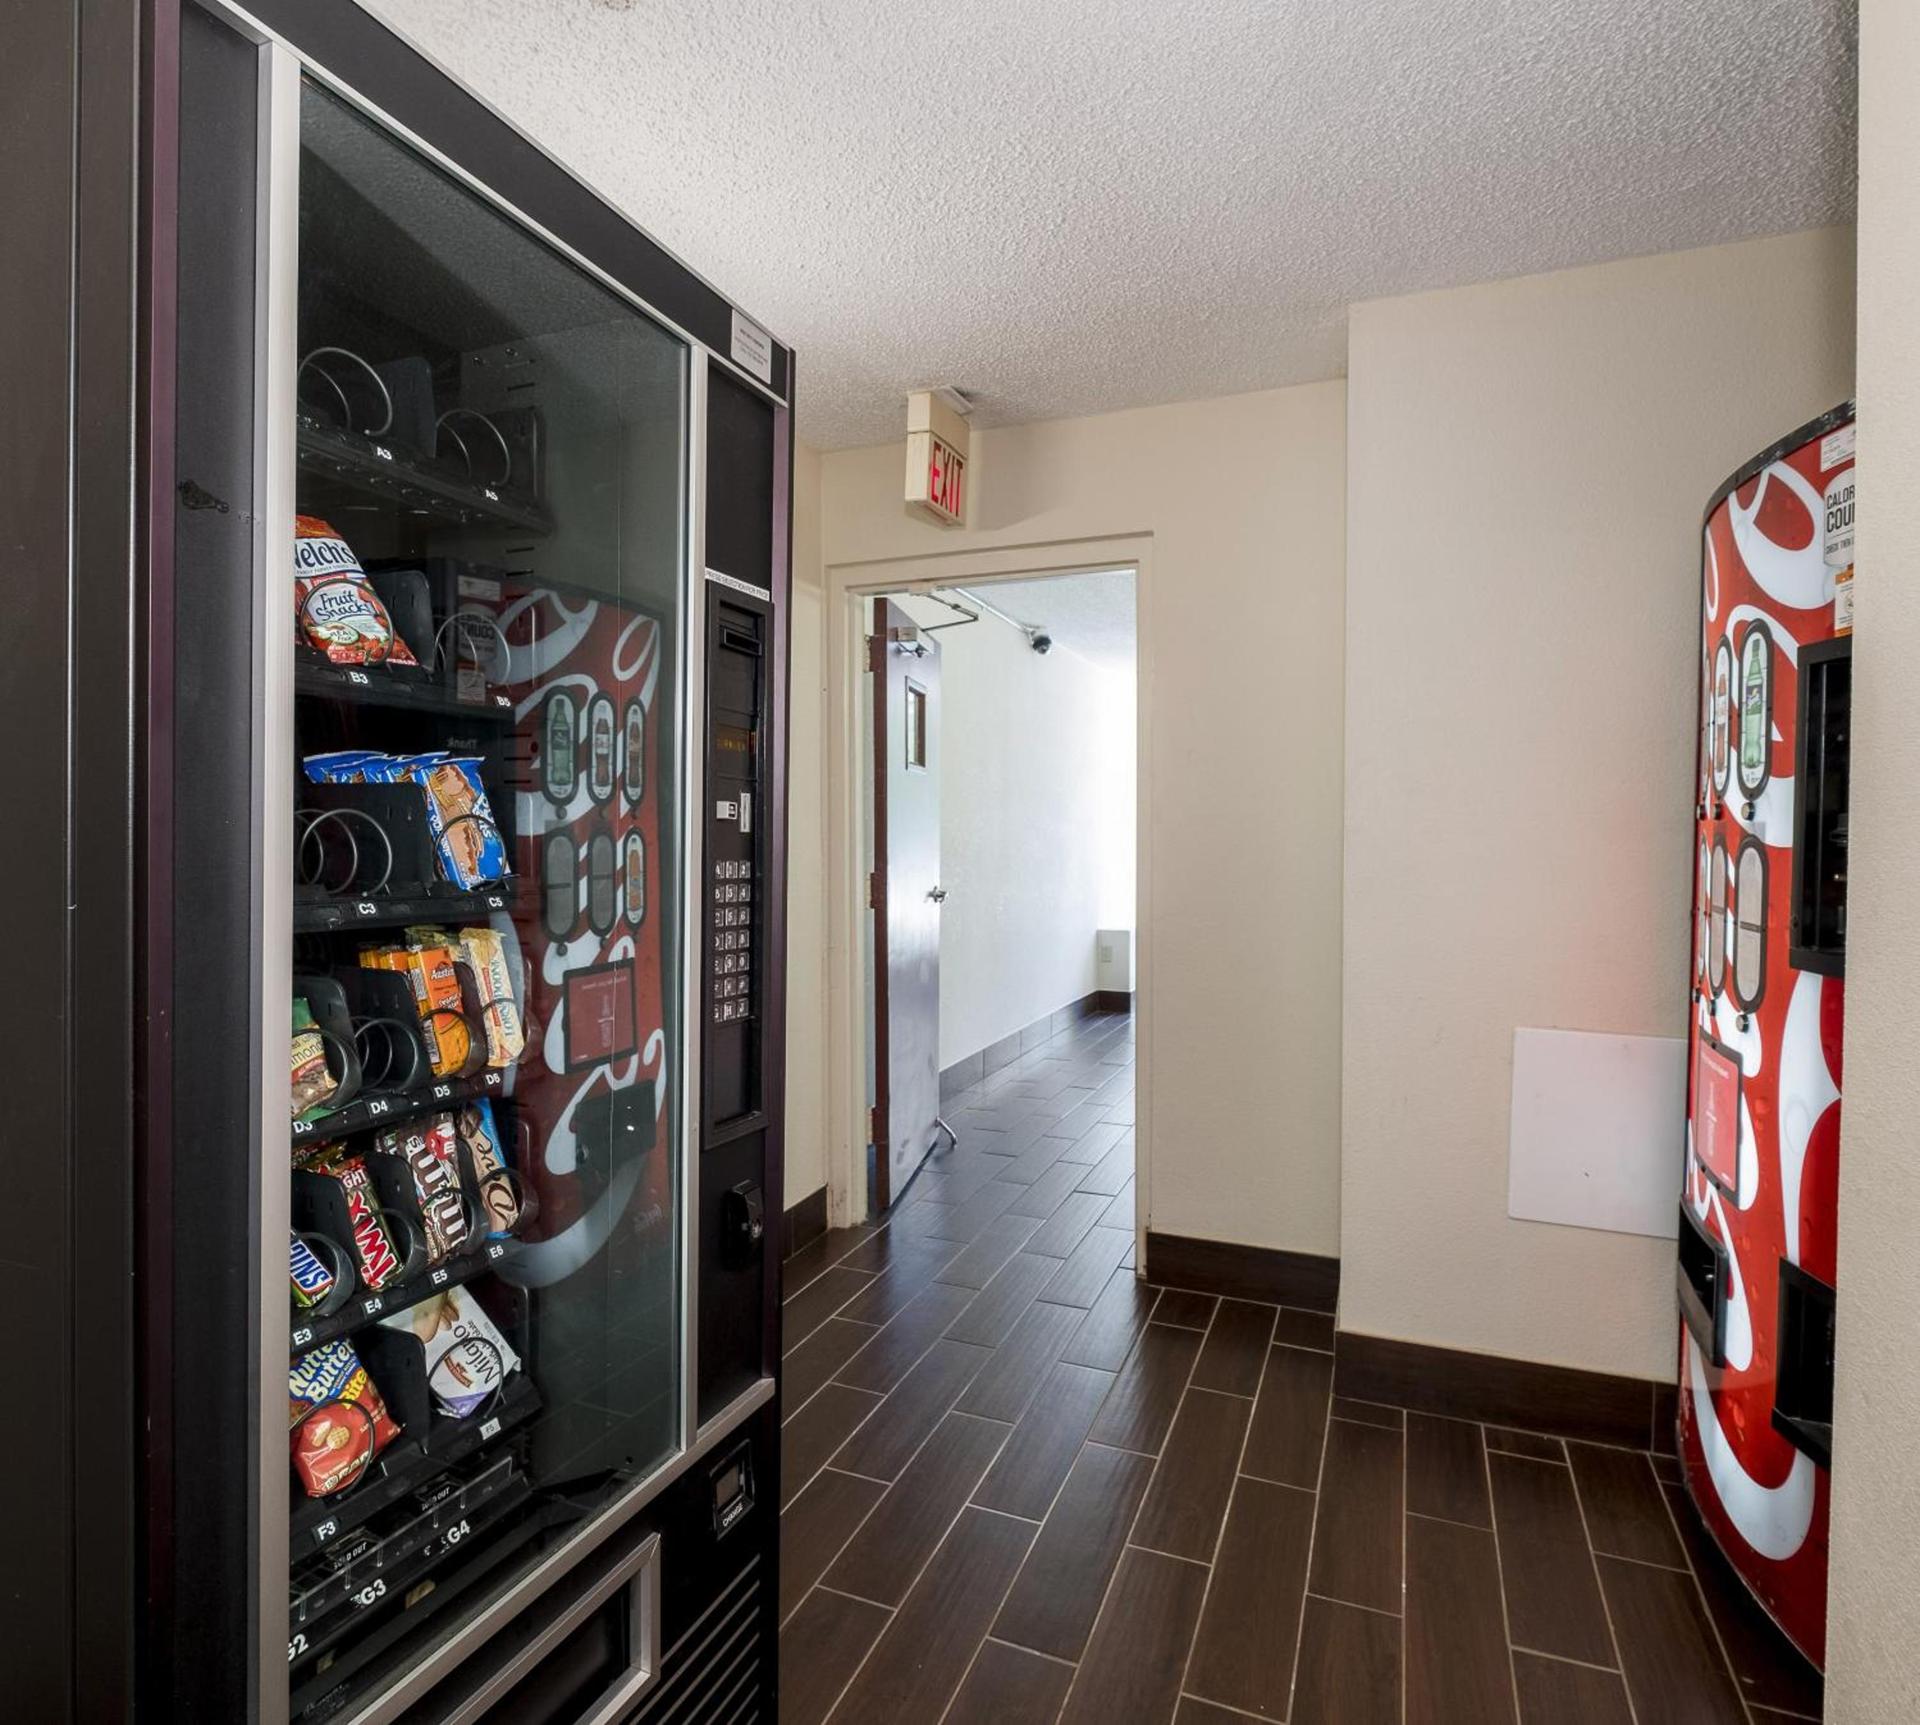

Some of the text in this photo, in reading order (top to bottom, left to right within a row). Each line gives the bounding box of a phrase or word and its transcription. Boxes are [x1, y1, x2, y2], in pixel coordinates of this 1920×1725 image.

[376, 446, 392, 460] A3
[930, 440, 963, 517] EXIT
[1826, 503, 1855, 533] COU
[319, 588, 356, 612] Fruit
[351, 672, 369, 685] B3
[359, 903, 376, 916] C3
[488, 897, 503, 907] C5
[484, 1072, 501, 1085] D6
[434, 1085, 451, 1098] D5
[370, 1100, 389, 1115] D4
[490, 1244, 504, 1259] E6
[432, 1270, 448, 1285] E5
[364, 1298, 382, 1315] E4
[293, 1328, 312, 1346] E3
[317, 1521, 336, 1541] F3
[447, 1519, 471, 1544] G4
